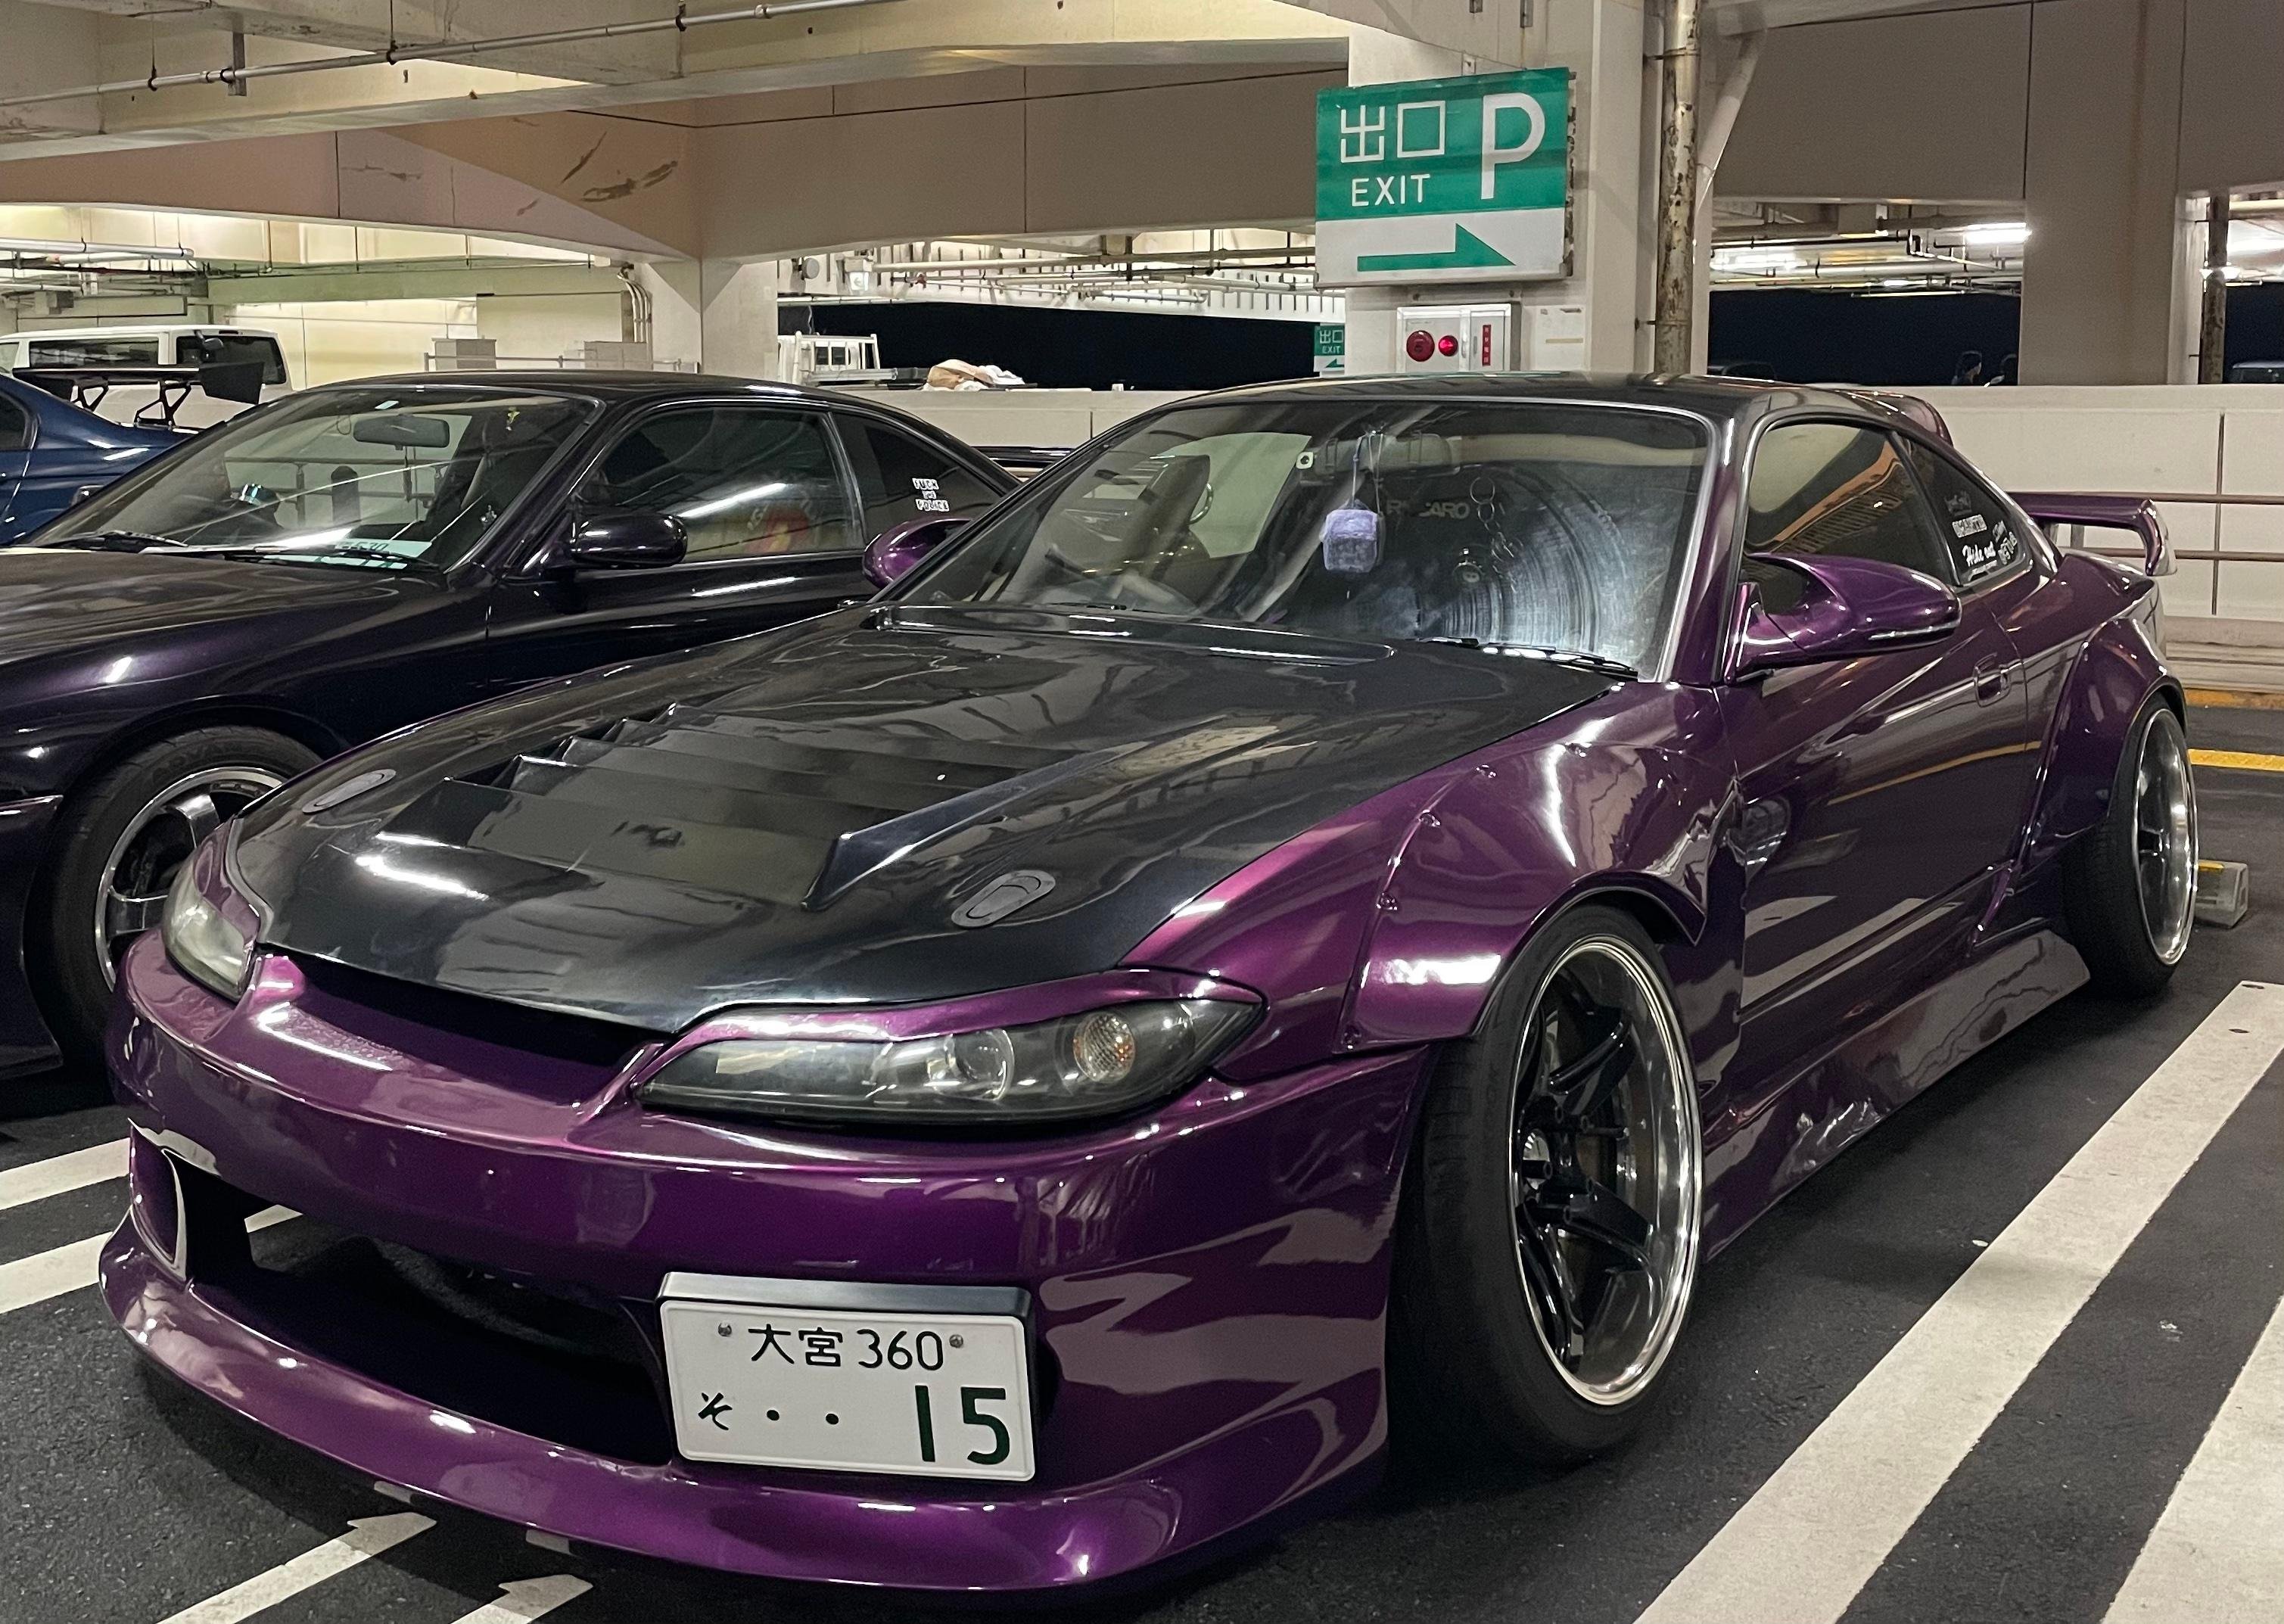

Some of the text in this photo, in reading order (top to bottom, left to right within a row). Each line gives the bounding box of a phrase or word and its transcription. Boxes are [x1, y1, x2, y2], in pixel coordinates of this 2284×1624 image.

[1340, 100, 1446, 163] 出口
[1480, 92, 1545, 200] P
[1352, 173, 1430, 207] EXIT
[1319, 329, 1343, 344] 出口
[1322, 345, 1341, 354] EXIT
[747, 1323, 944, 1371] 大宮 360
[698, 1392, 733, 1431] そ
[914, 1385, 1011, 1465] 15
